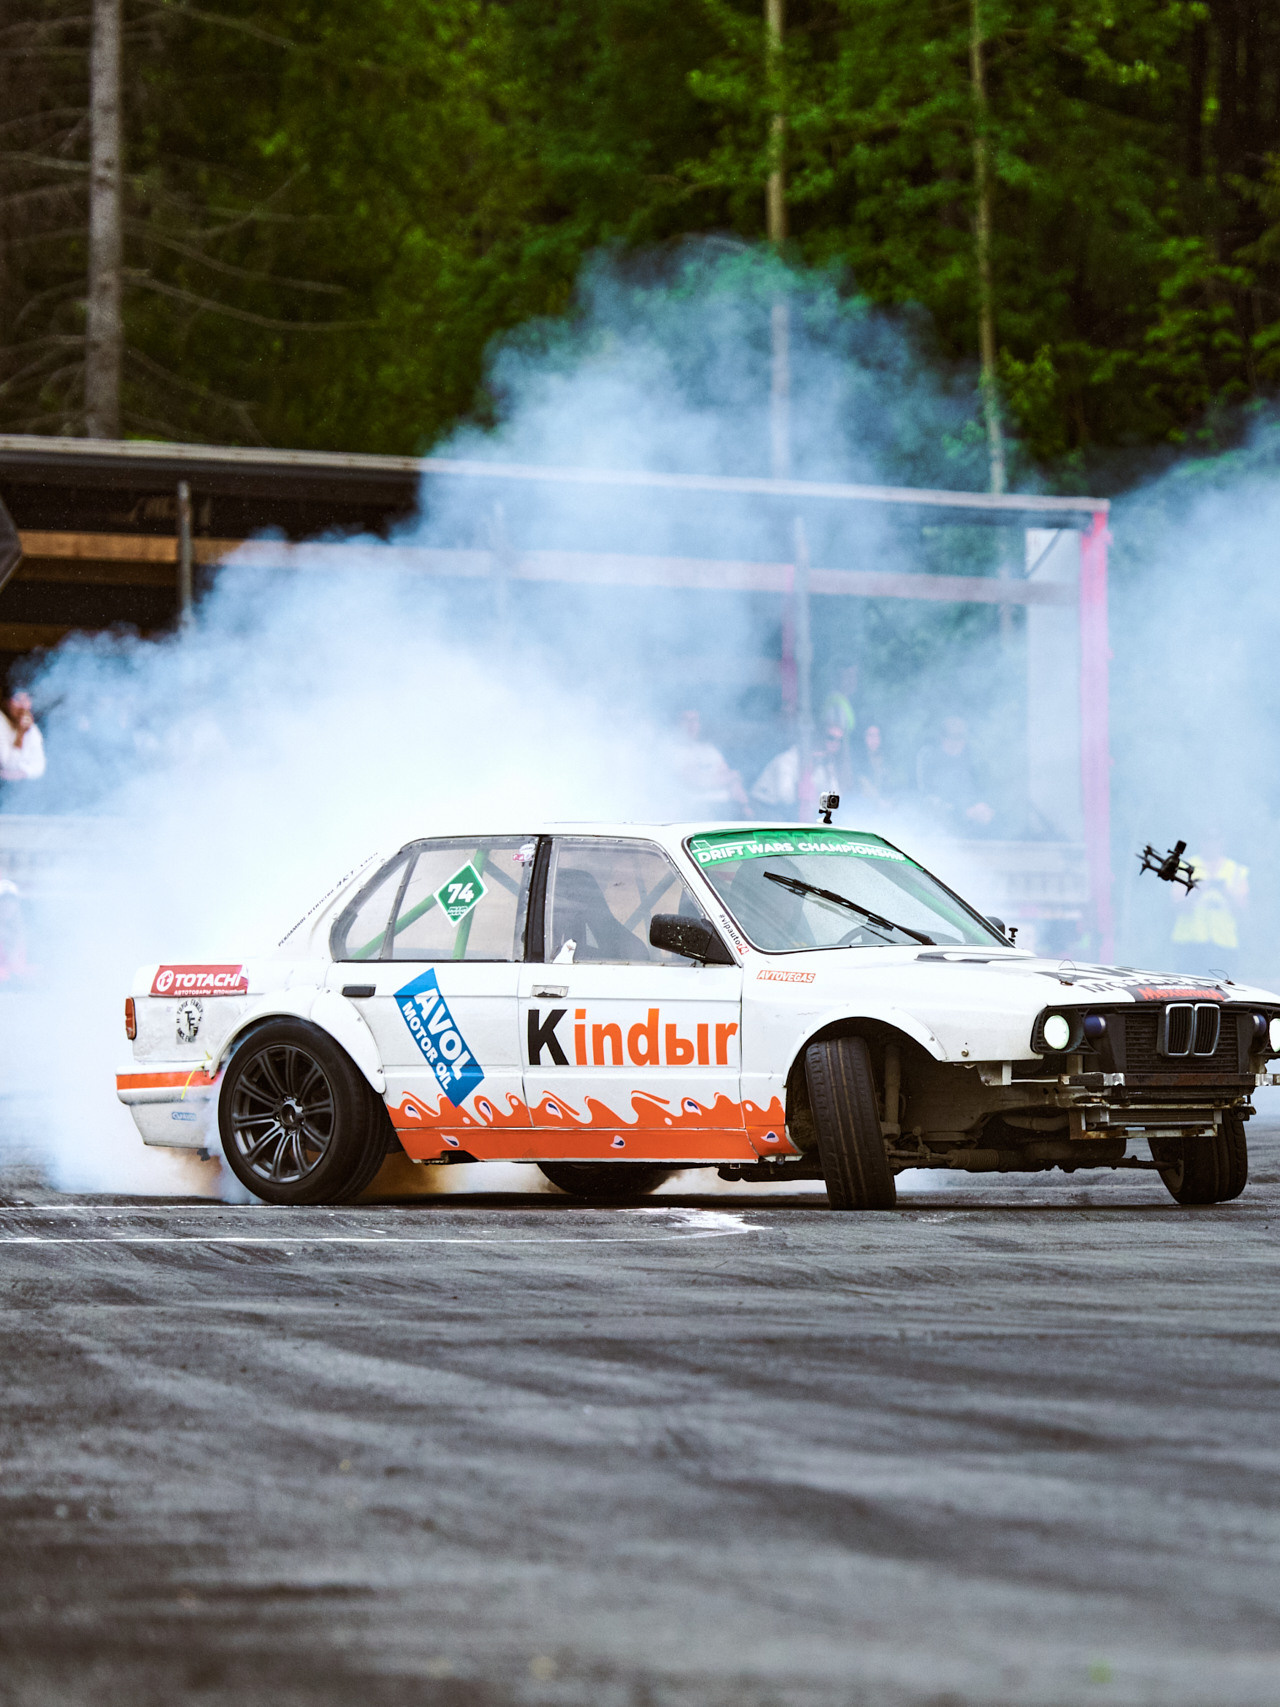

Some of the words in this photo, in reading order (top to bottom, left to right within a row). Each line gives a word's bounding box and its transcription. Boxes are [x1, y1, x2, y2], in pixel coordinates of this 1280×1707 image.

[697, 845, 744, 863] DRIFT
[747, 843, 795, 855] WARS
[798, 843, 906, 861] CHAMPIONSHIP
[447, 882, 475, 904] 74
[174, 973, 241, 988] TOTACHI
[757, 970, 815, 983] AVTOVEGAS
[413, 987, 471, 1081] AVOL
[402, 1000, 439, 1063] MOTOR
[435, 1061, 452, 1090] OIL
